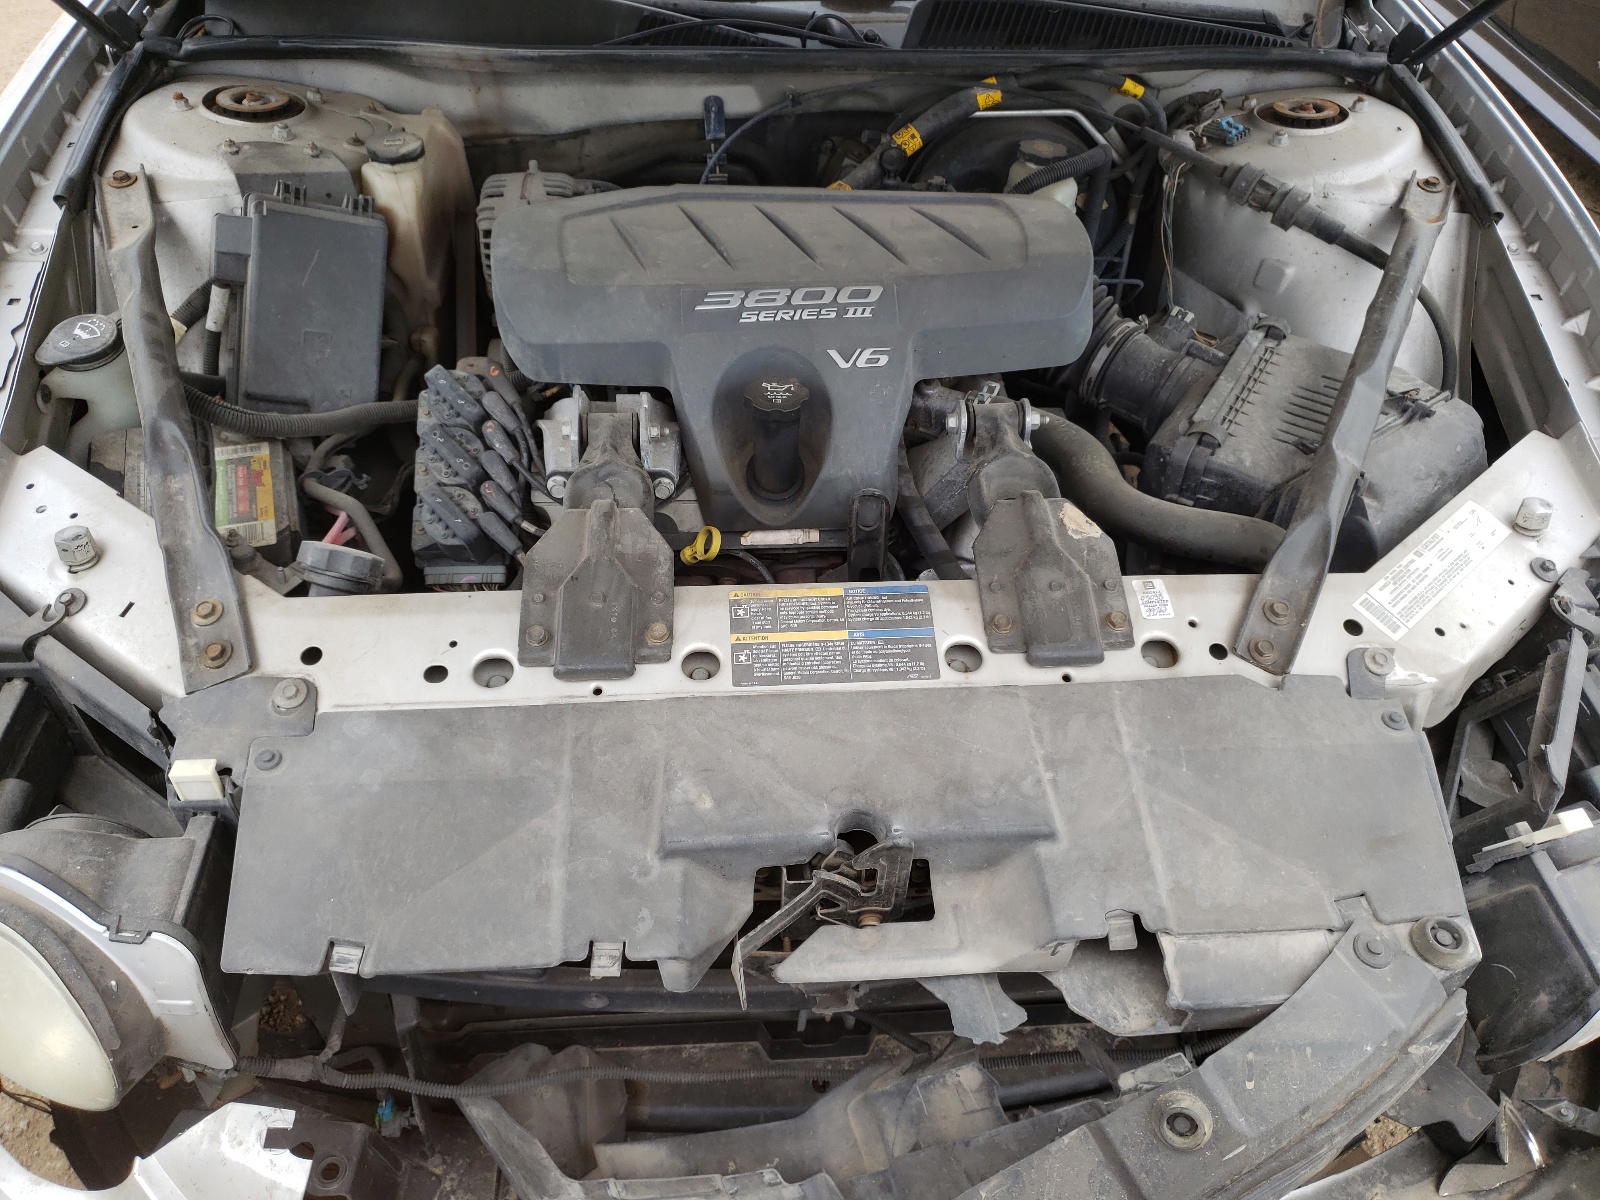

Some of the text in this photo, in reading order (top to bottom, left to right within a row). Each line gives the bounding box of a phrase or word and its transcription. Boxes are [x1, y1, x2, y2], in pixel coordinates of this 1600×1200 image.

[694, 285, 884, 311] 3800
[738, 306, 875, 323] SERIES III
[826, 347, 891, 369] V6
